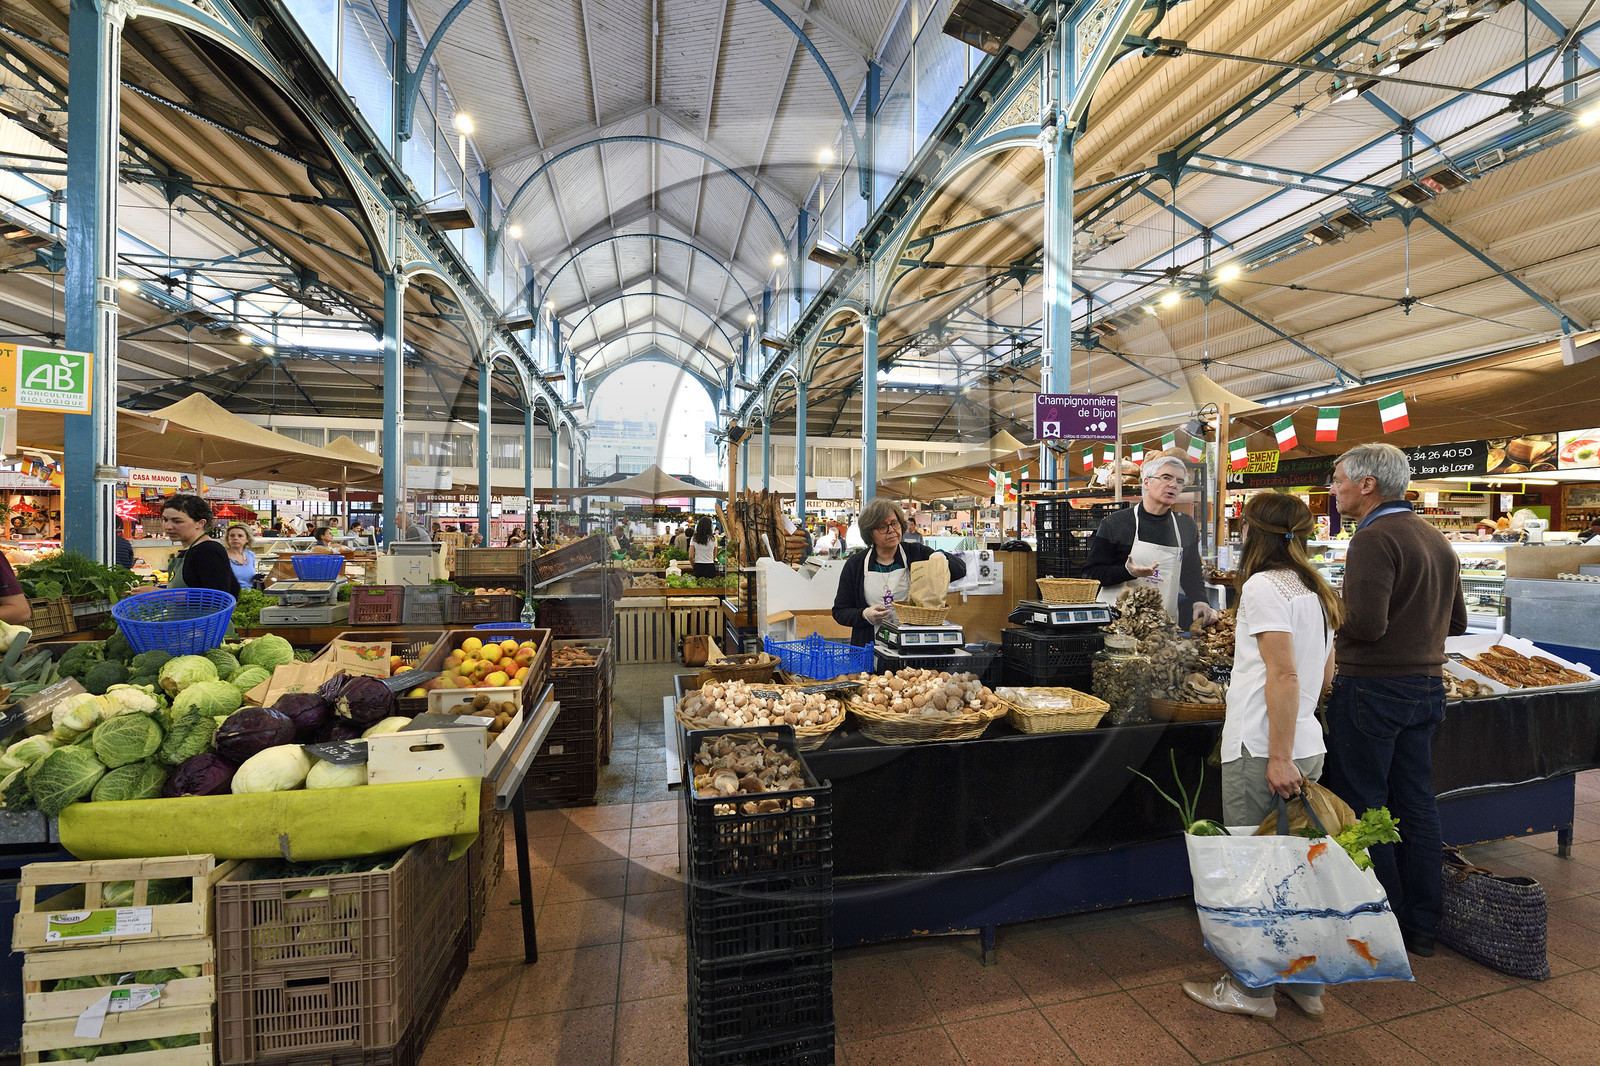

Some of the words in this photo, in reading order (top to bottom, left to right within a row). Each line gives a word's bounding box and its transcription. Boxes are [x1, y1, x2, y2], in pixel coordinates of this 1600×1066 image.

[25, 364, 74, 390] AB
[21, 390, 84, 400] AGRICULTURE
[21, 396, 84, 406] BIOLOGIQUE
[1038, 395, 1116, 407] Champignonnière
[1078, 408, 1090, 417] de
[1093, 408, 1116, 420] Dijon
[1428, 451, 1440, 460] 26
[1442, 449, 1456, 458] 40
[1459, 448, 1472, 457] 50
[1419, 466, 1437, 474] Jean
[1450, 464, 1474, 472] Losne
[1249, 477, 1288, 486] Importation
[1290, 475, 1318, 484] Directe
